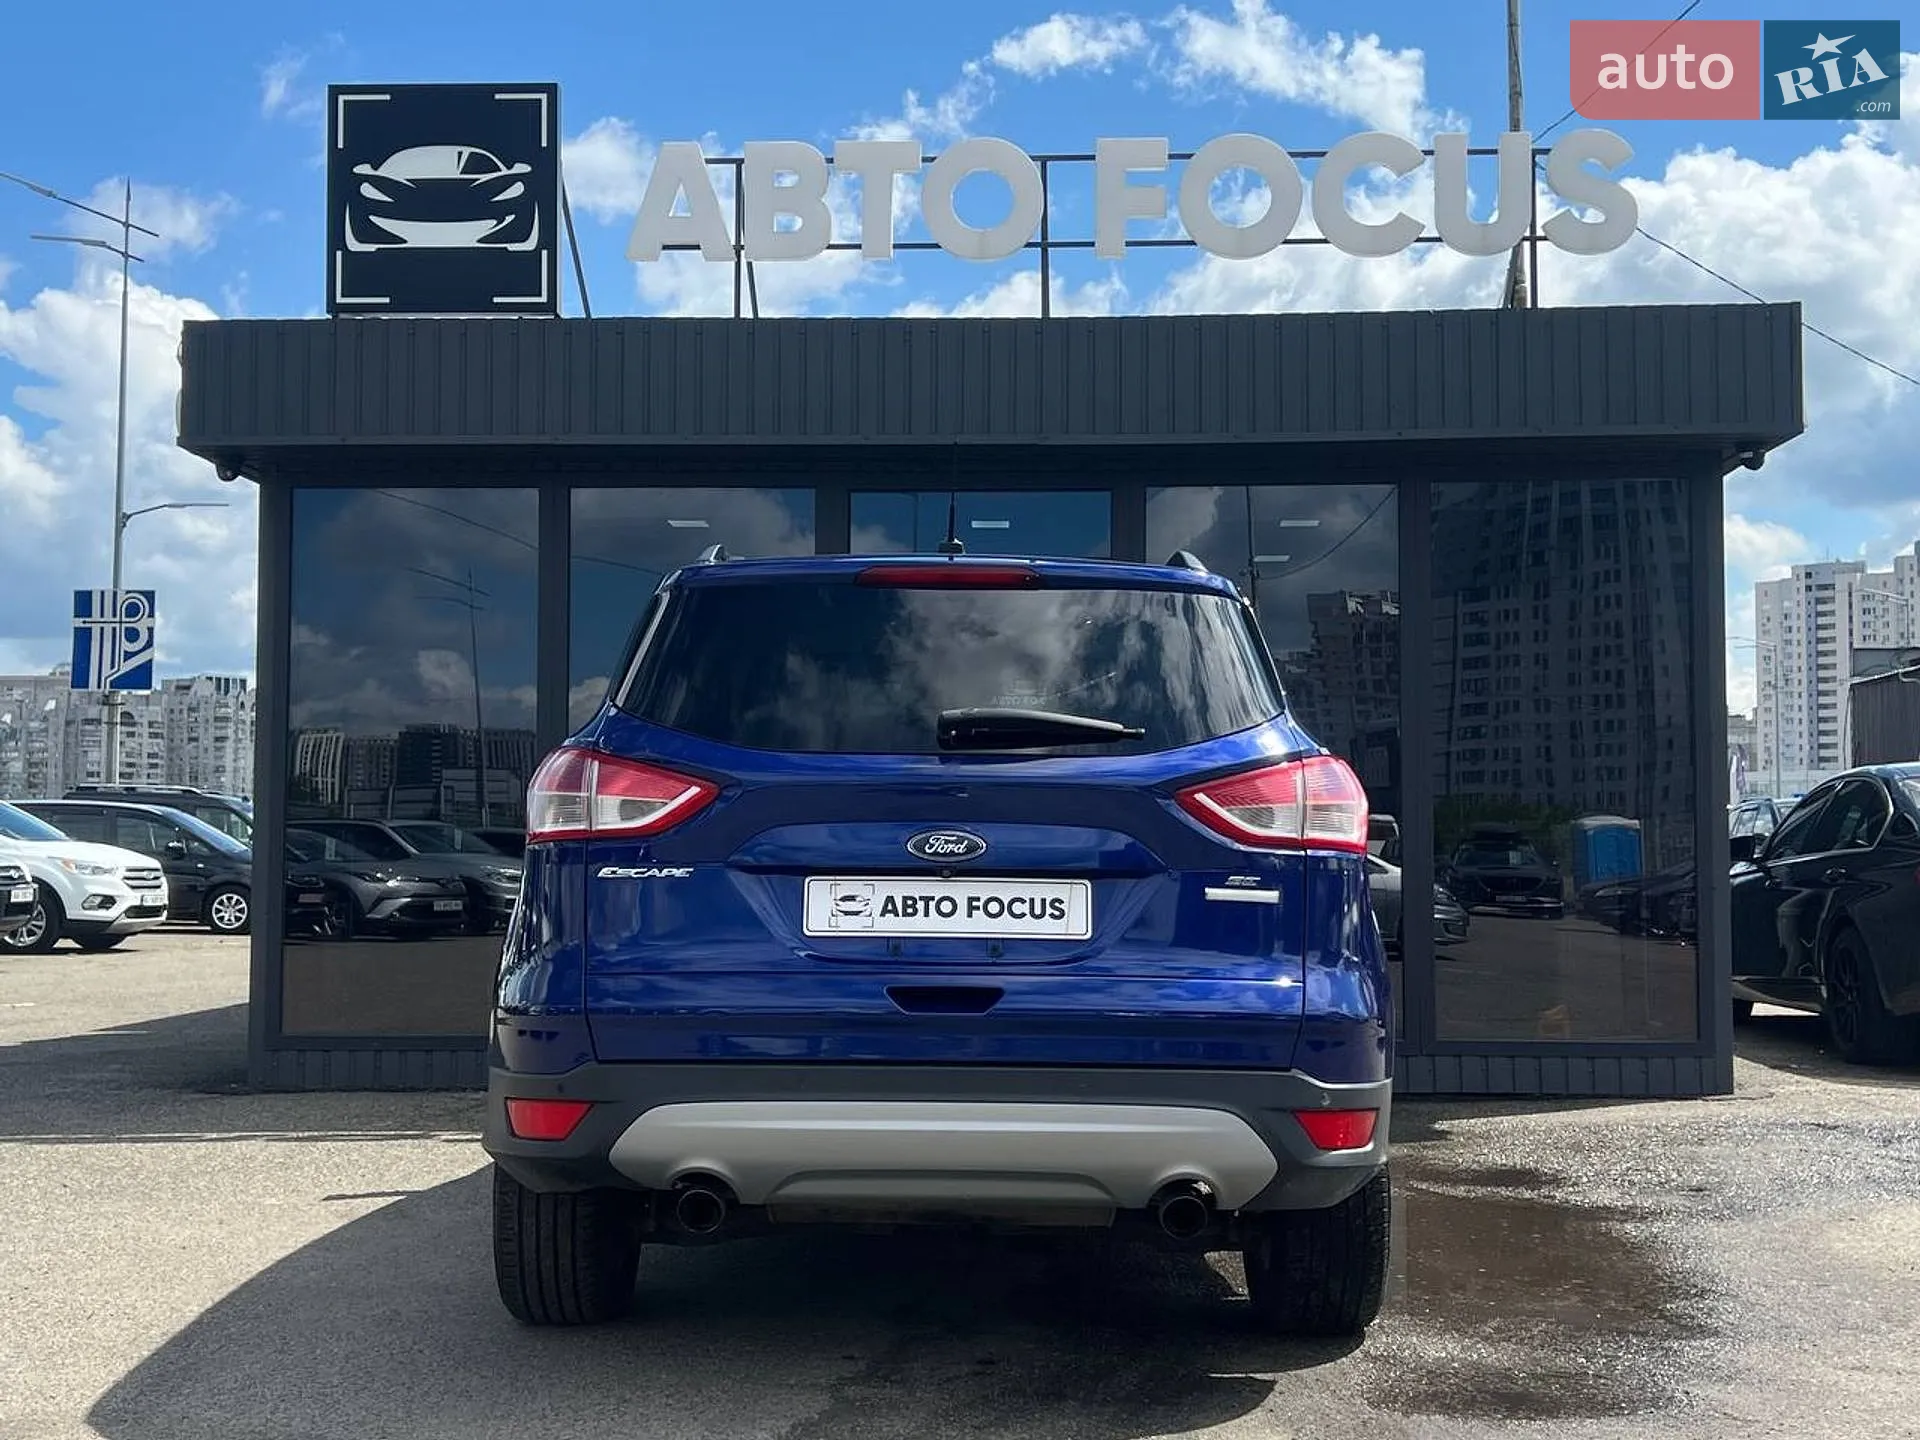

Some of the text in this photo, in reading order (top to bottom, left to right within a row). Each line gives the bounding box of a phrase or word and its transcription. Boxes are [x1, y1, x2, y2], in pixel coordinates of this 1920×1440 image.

[626, 129, 1638, 262] АВТО FOCUS
[925, 835, 968, 853] Ford
[597, 866, 694, 878] ESCAPE
[879, 895, 1066, 920] АВТО FOCUS
